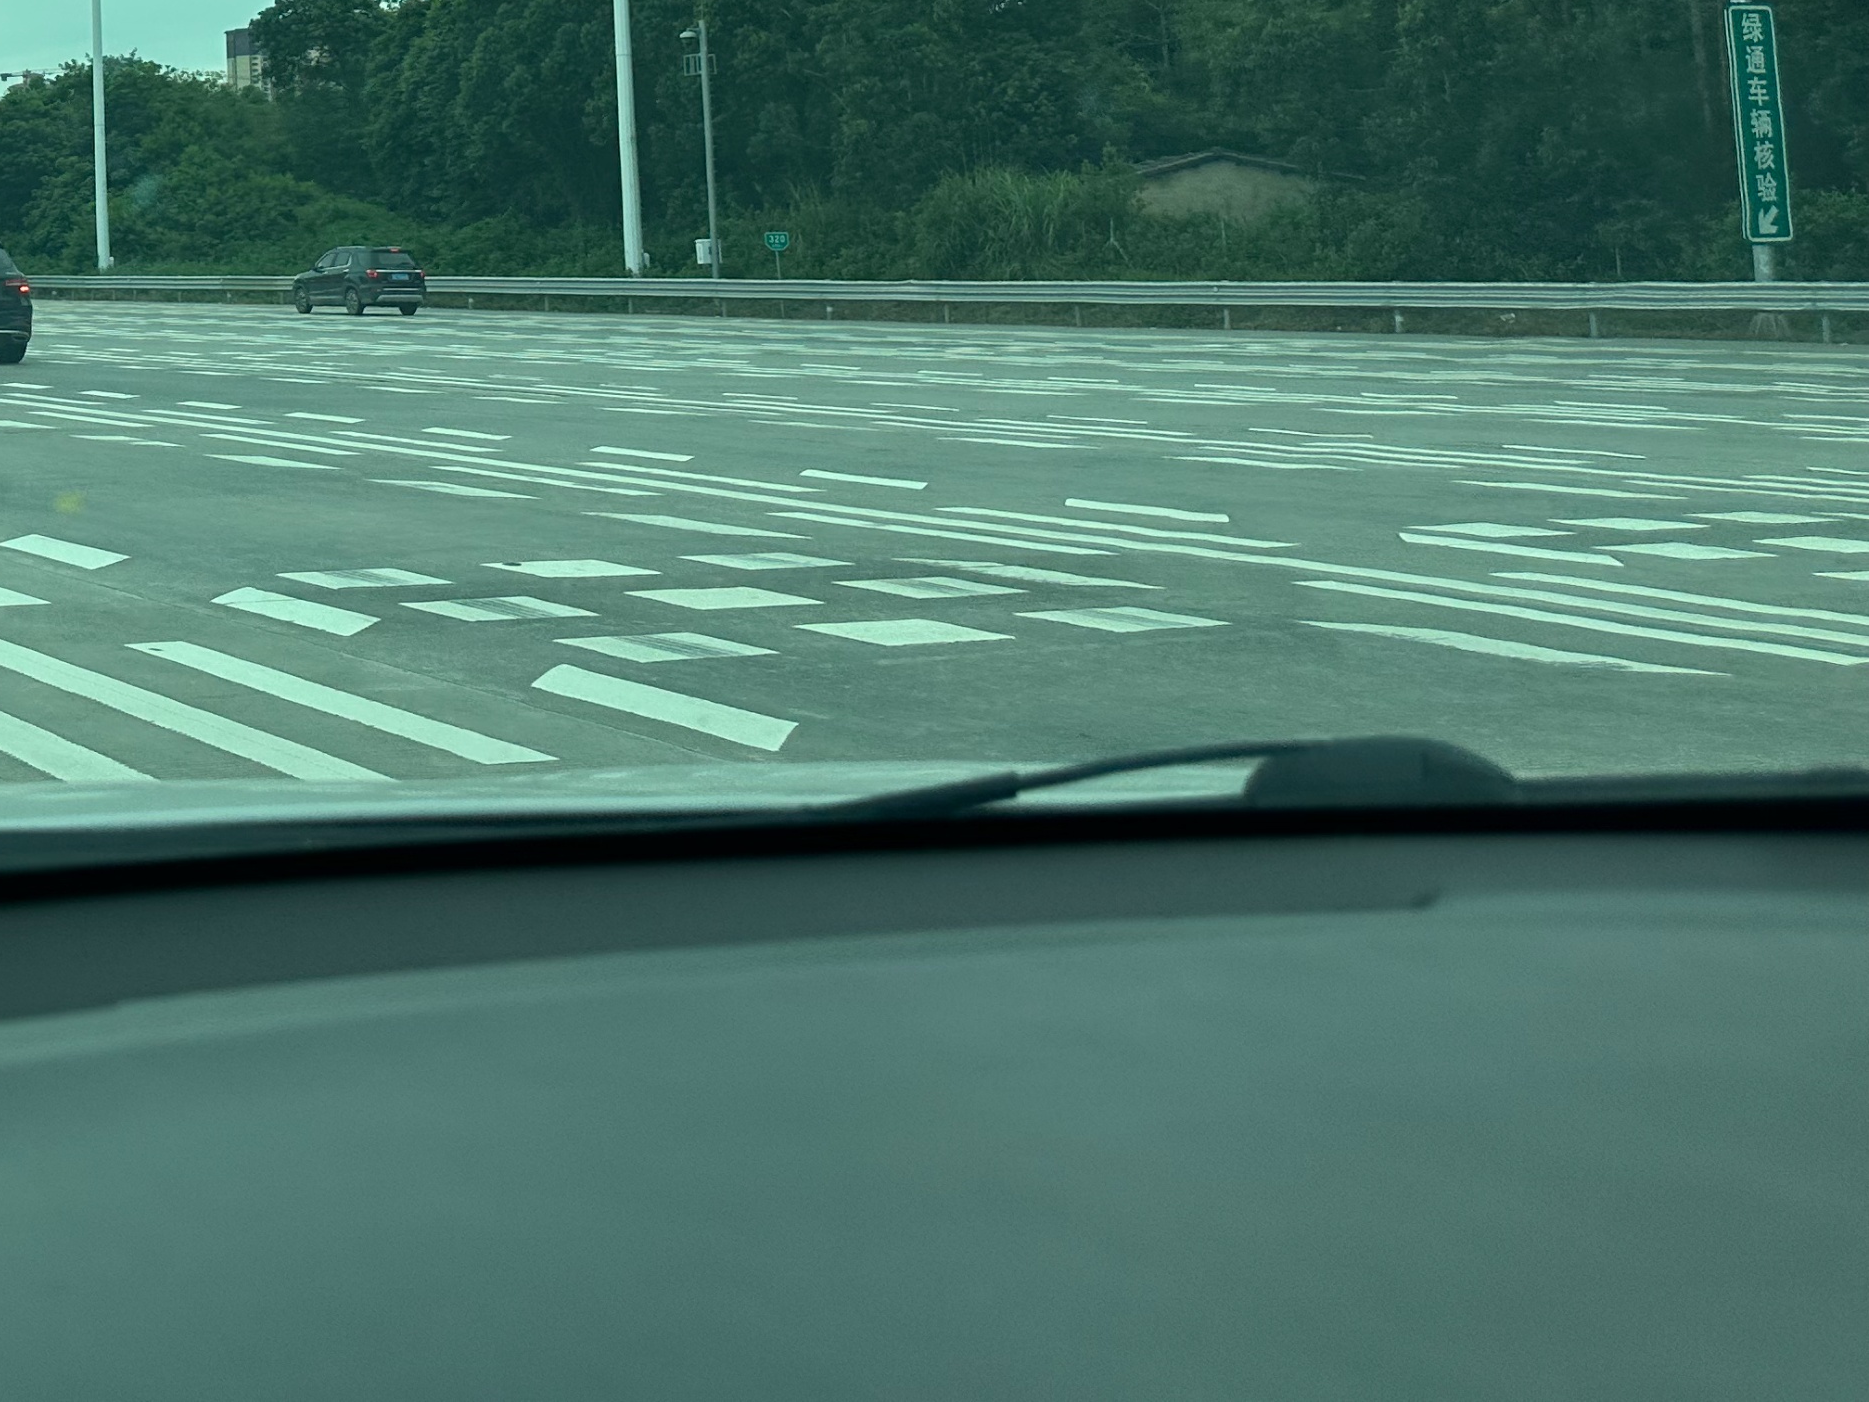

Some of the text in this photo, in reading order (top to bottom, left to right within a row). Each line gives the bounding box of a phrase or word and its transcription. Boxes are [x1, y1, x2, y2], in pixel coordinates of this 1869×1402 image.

[1740, 12, 1779, 202] 绿通车辆核验
[768, 234, 786, 243] 320
